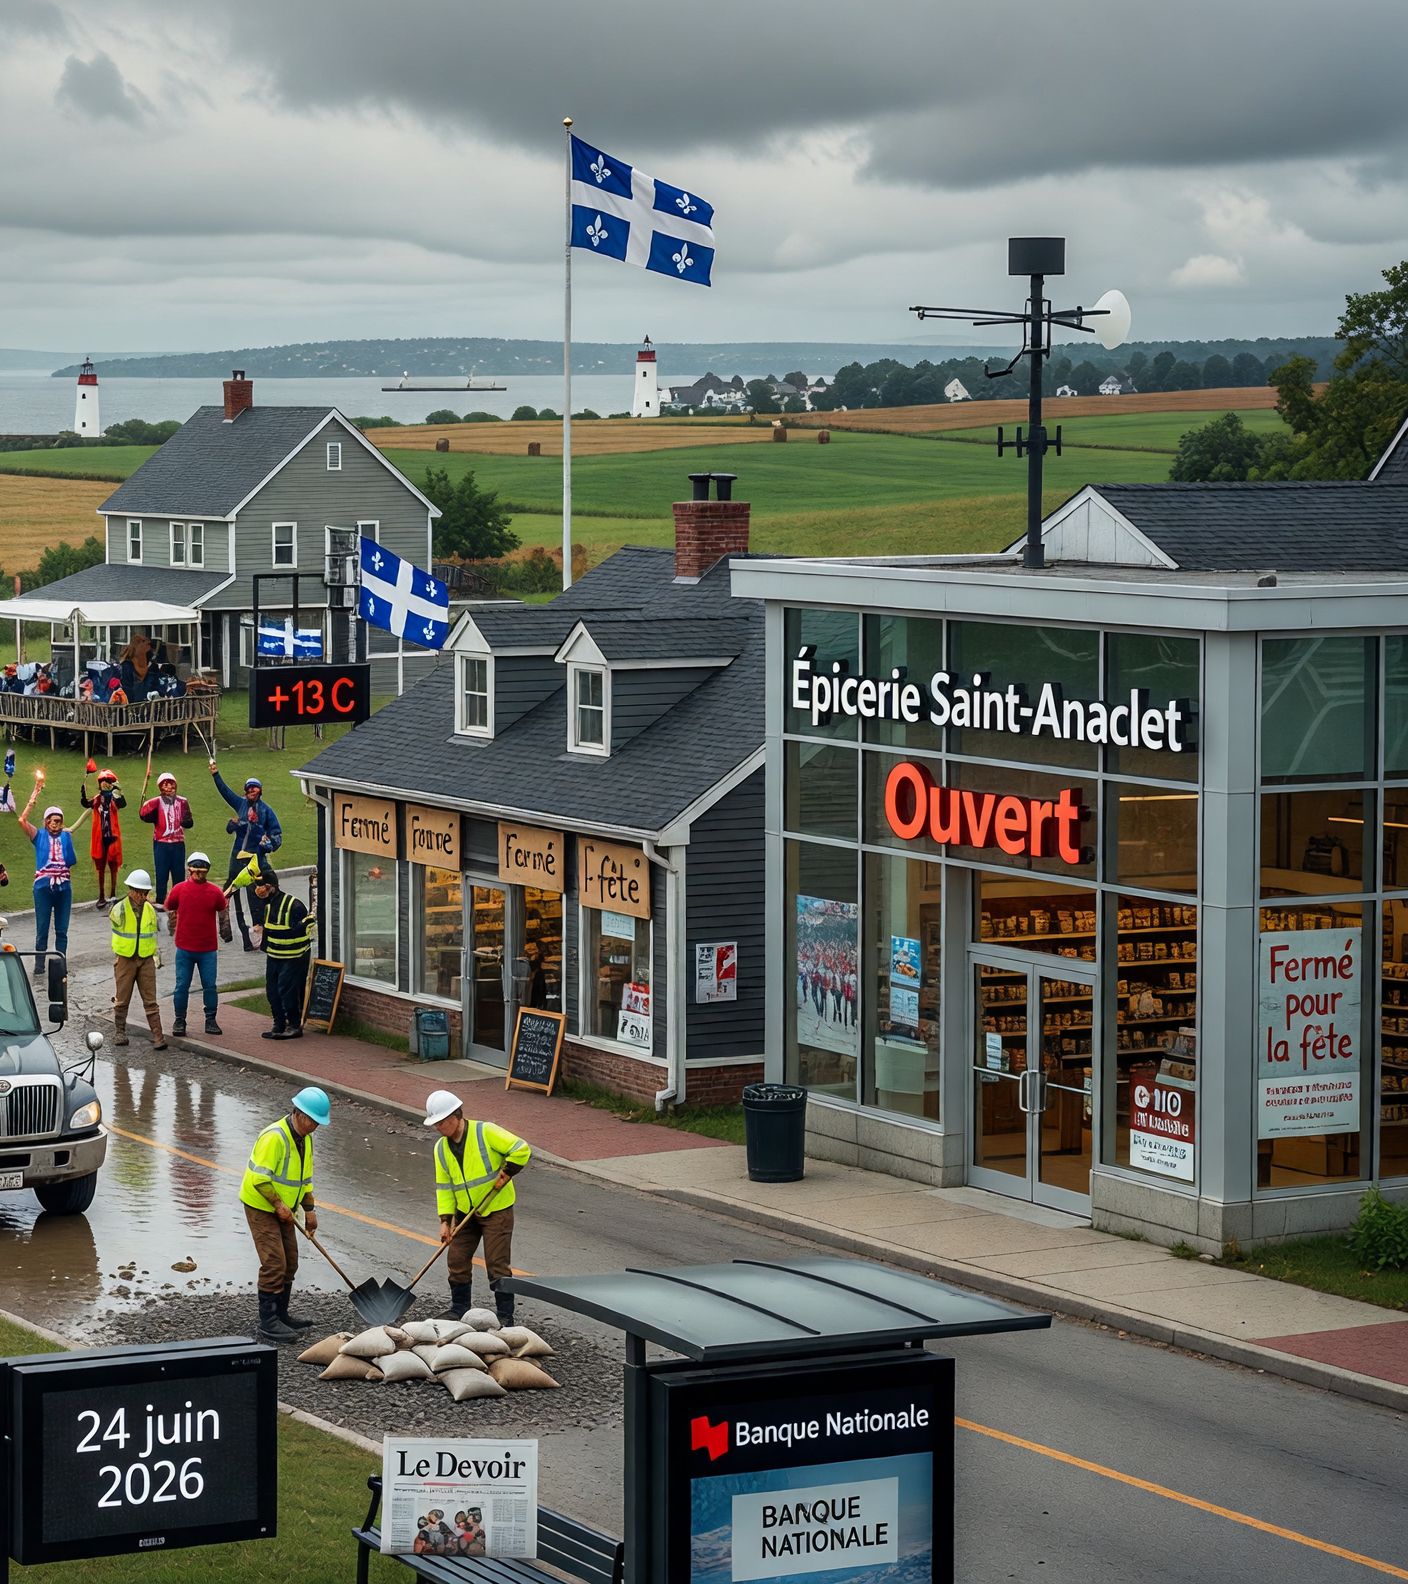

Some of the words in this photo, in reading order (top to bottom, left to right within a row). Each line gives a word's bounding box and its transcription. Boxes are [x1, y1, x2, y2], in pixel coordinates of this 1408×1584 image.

[268, 680, 325, 714] +13
[332, 677, 355, 713] C
[792, 646, 920, 726] Épicerie
[930, 671, 1183, 752] Saint-Anaclet
[884, 761, 1081, 865] Ouvert
[1270, 938, 1353, 984] Fermé
[1285, 991, 1343, 1031] pour
[1267, 1026, 1290, 1063] la
[1300, 1022, 1353, 1071] fête
[76, 1407, 130, 1453] 24
[138, 1400, 220, 1458] juin
[735, 1420, 819, 1448] Banque
[826, 1403, 929, 1437] Nationale
[97, 1457, 205, 1508] 2026
[396, 1450, 431, 1478] Le
[435, 1451, 526, 1479] Devoir
[762, 1496, 861, 1529] BANQUE
[761, 1522, 888, 1559] NATIONALE
